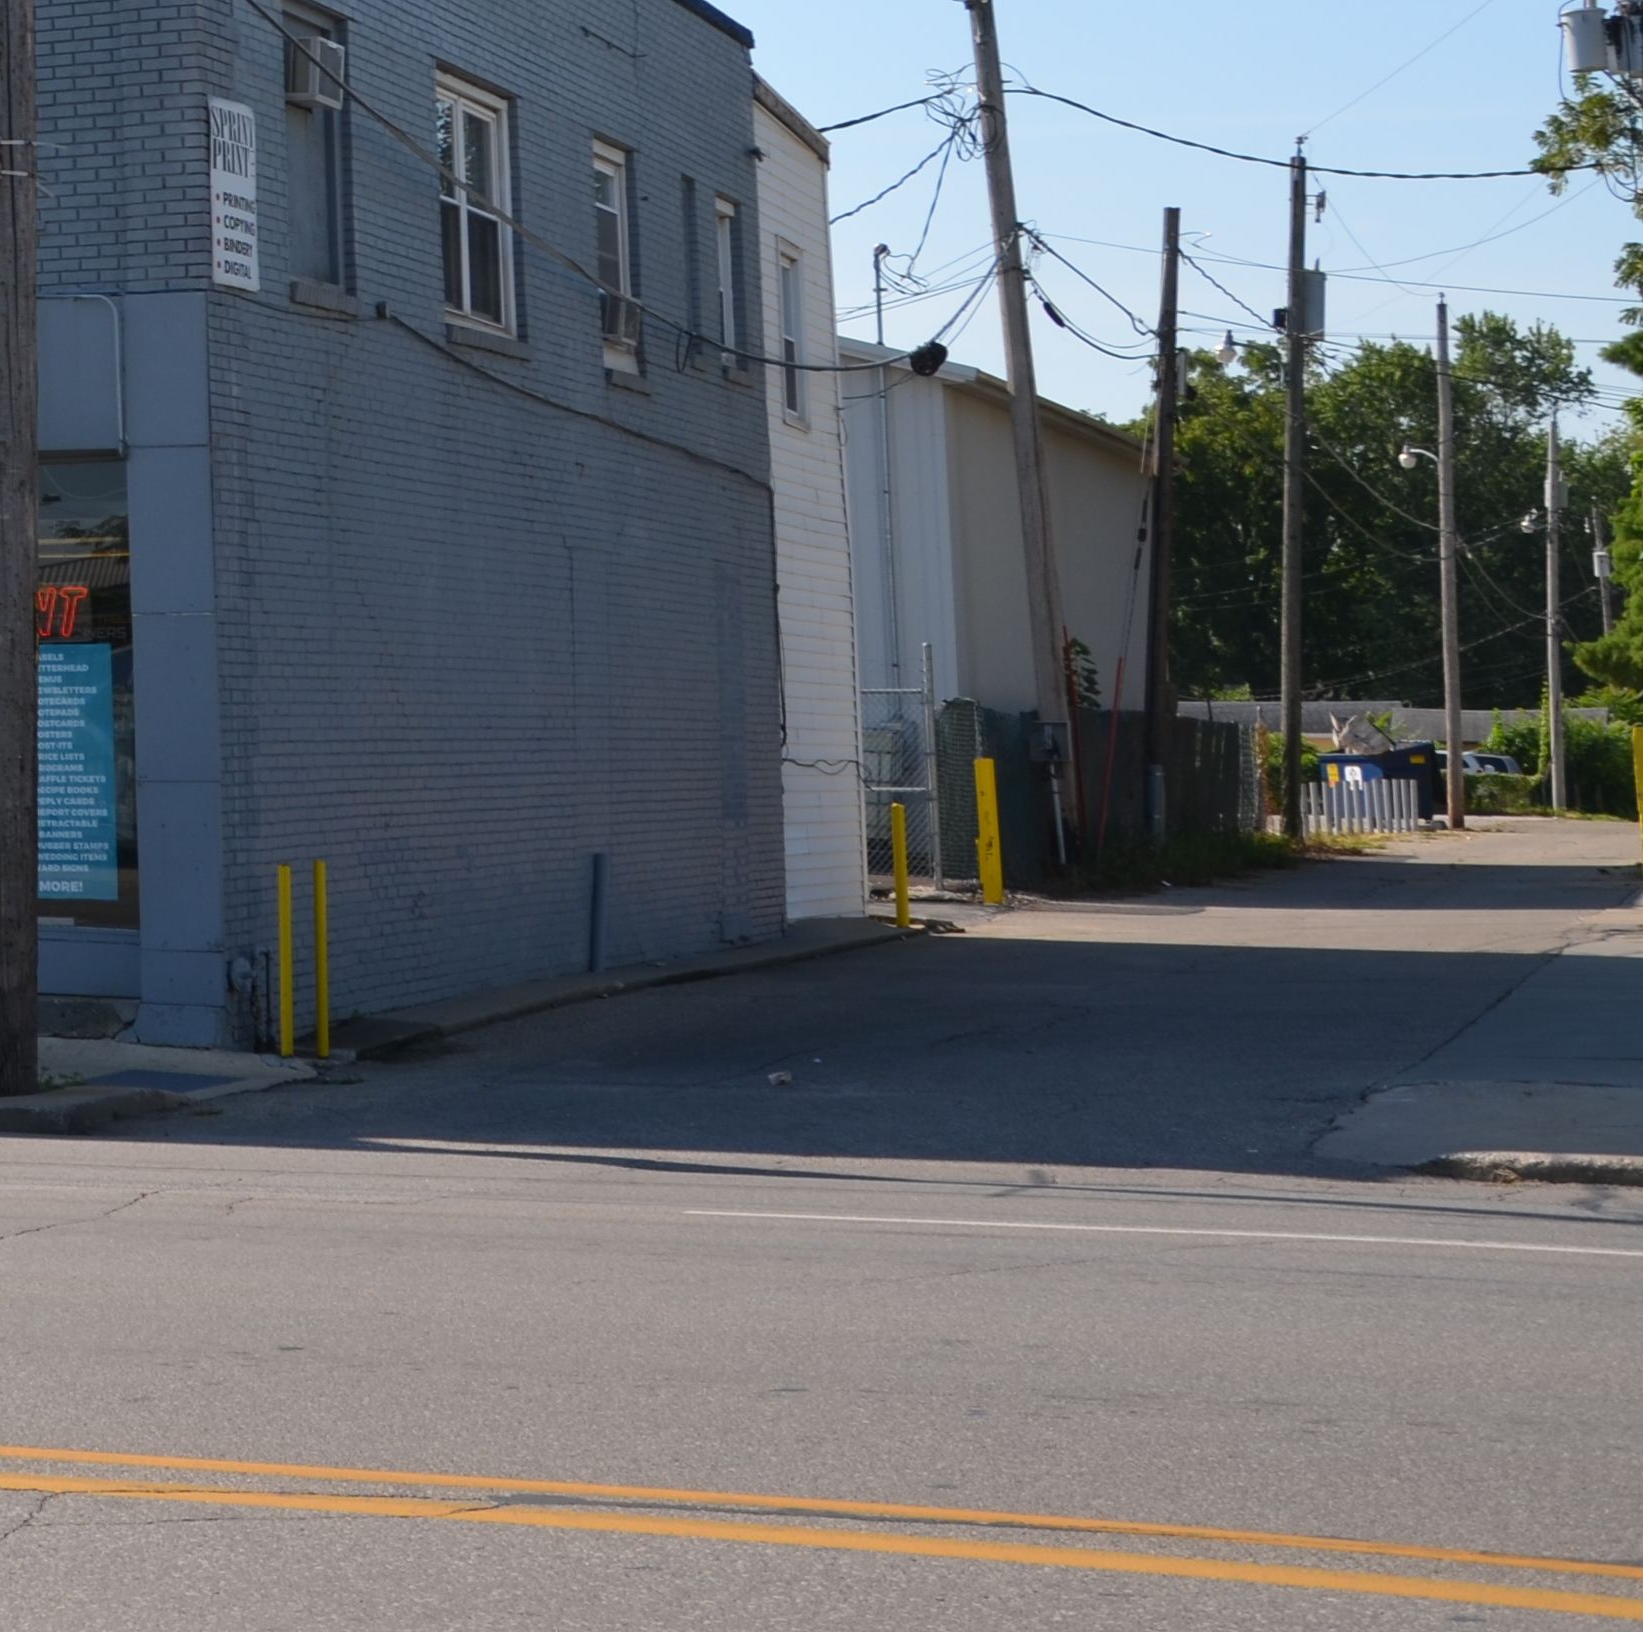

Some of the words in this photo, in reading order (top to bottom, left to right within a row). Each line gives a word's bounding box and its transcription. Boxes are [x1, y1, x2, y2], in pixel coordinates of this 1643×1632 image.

[211, 106, 254, 149] SPRINT
[213, 138, 251, 179] PRINT
[223, 191, 255, 215] PRINTING
[223, 214, 255, 237] COPYING
[223, 237, 253, 258] BINDERY
[224, 259, 252, 280] DIGITAL
[38, 664, 89, 672] TTERHEAD
[38, 686, 97, 694] WSLETTERS
[38, 698, 86, 706] OTECARDS
[38, 709, 80, 717] OTEPADS
[37, 720, 86, 728] OSTCARDS
[37, 731, 73, 739] OSTERS
[38, 742, 73, 750] OST-ITS
[60, 753, 85, 761] LISTS
[38, 764, 84, 772] ROGRAMS
[38, 775, 66, 783] AFFLE
[69, 775, 106, 783] TICKETS
[38, 786, 66, 794] ECIPE
[67, 786, 99, 794] BOOKS
[38, 797, 62, 805] EPLY
[38, 808, 69, 816] EPORT
[71, 808, 108, 816] COVERS
[38, 820, 98, 828] ETRACTABLE
[38, 842, 71, 850] UBBER
[73, 842, 109, 850] STAMPS
[80, 853, 107, 861] ITEMS
[39, 880, 83, 892] MORE!
